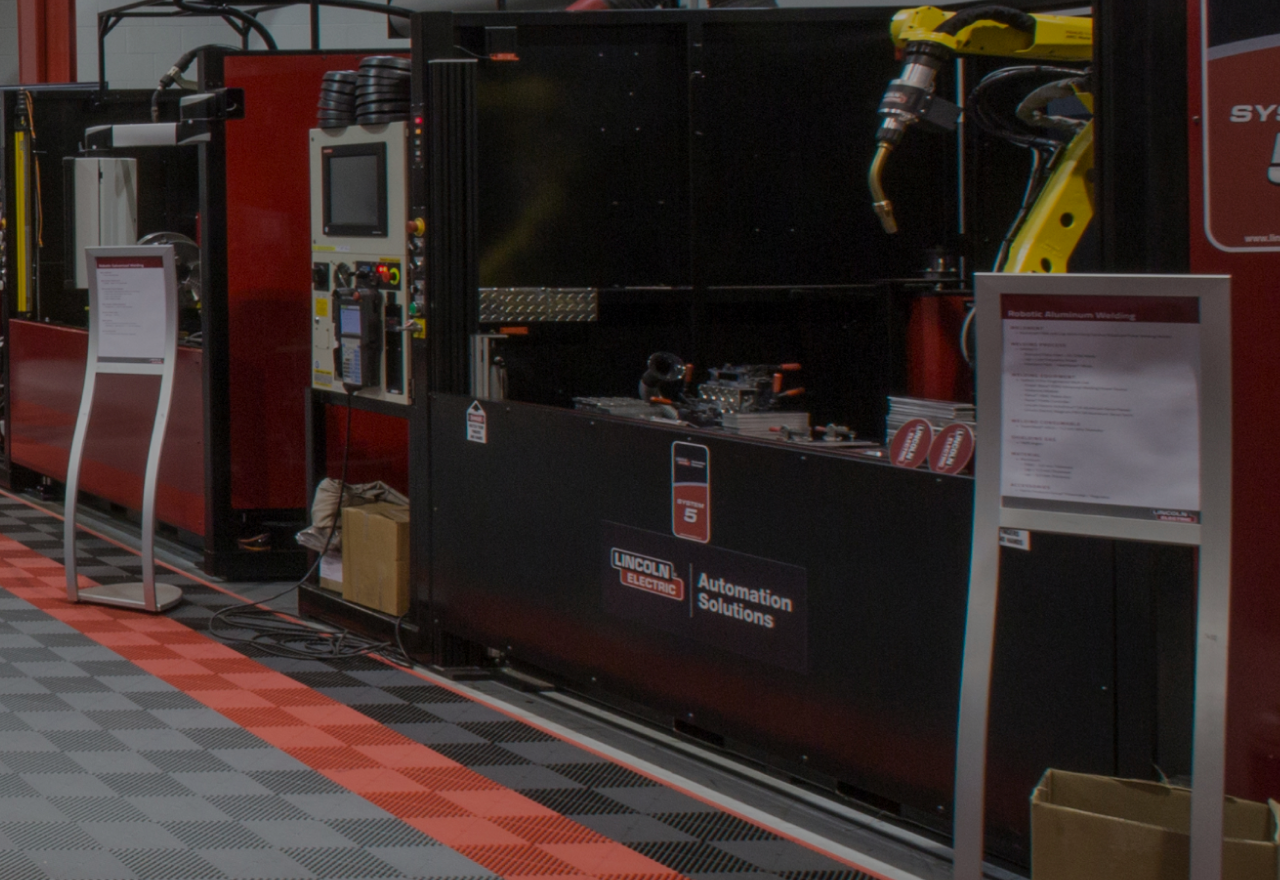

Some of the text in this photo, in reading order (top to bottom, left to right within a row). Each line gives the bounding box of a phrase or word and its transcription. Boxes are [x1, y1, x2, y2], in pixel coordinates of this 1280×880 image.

[1008, 310, 1136, 321] Robotic Aluminum Welding
[905, 424, 926, 460] LINCOLN
[945, 429, 965, 466] LINCOLN
[676, 498, 705, 509] SYSTEM
[683, 507, 698, 523] 5
[614, 551, 670, 580] LINCOLN
[627, 572, 677, 596] ELECTRIC
[697, 571, 793, 613] Automation
[697, 592, 775, 629] Solutions
